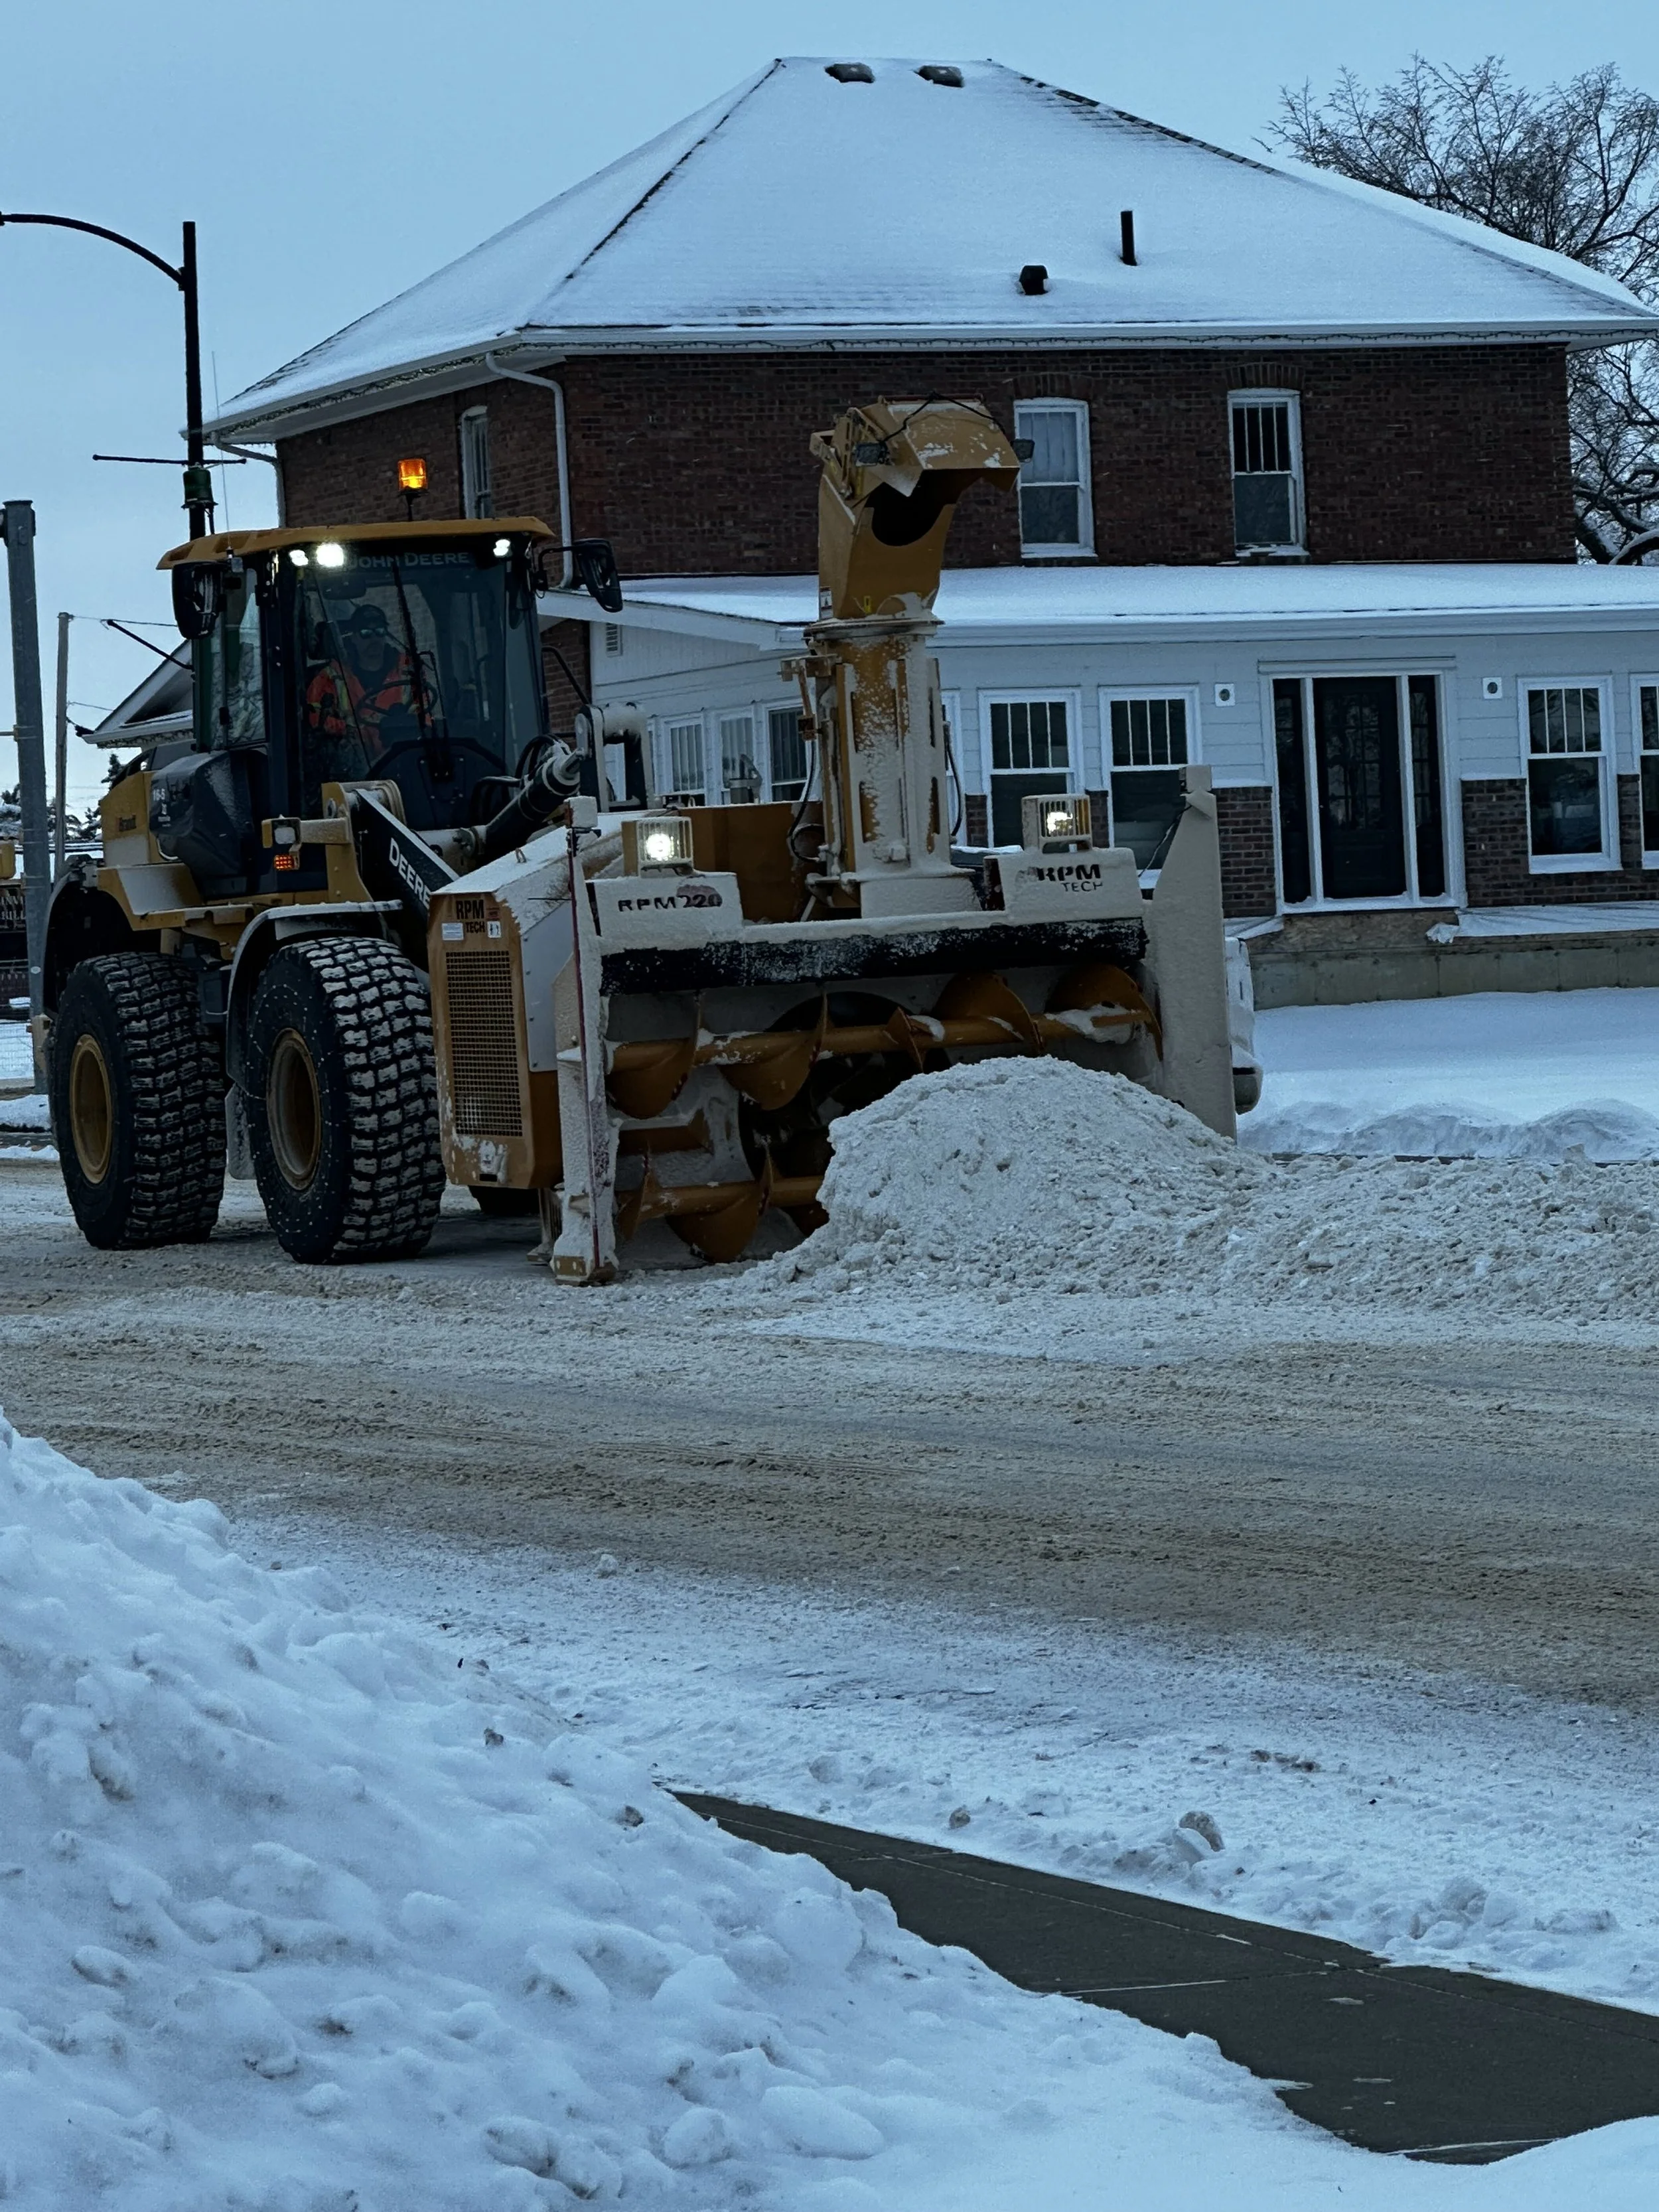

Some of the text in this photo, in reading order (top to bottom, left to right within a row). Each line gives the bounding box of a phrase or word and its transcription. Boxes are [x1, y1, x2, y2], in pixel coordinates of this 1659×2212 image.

[347, 552, 470, 569] JOHN DEERE
[389, 837, 431, 910] DEERE
[1037, 864, 1101, 881] RPM
[1061, 881, 1103, 892] TECH
[456, 899, 485, 920] RPM
[465, 921, 485, 934] TECH
